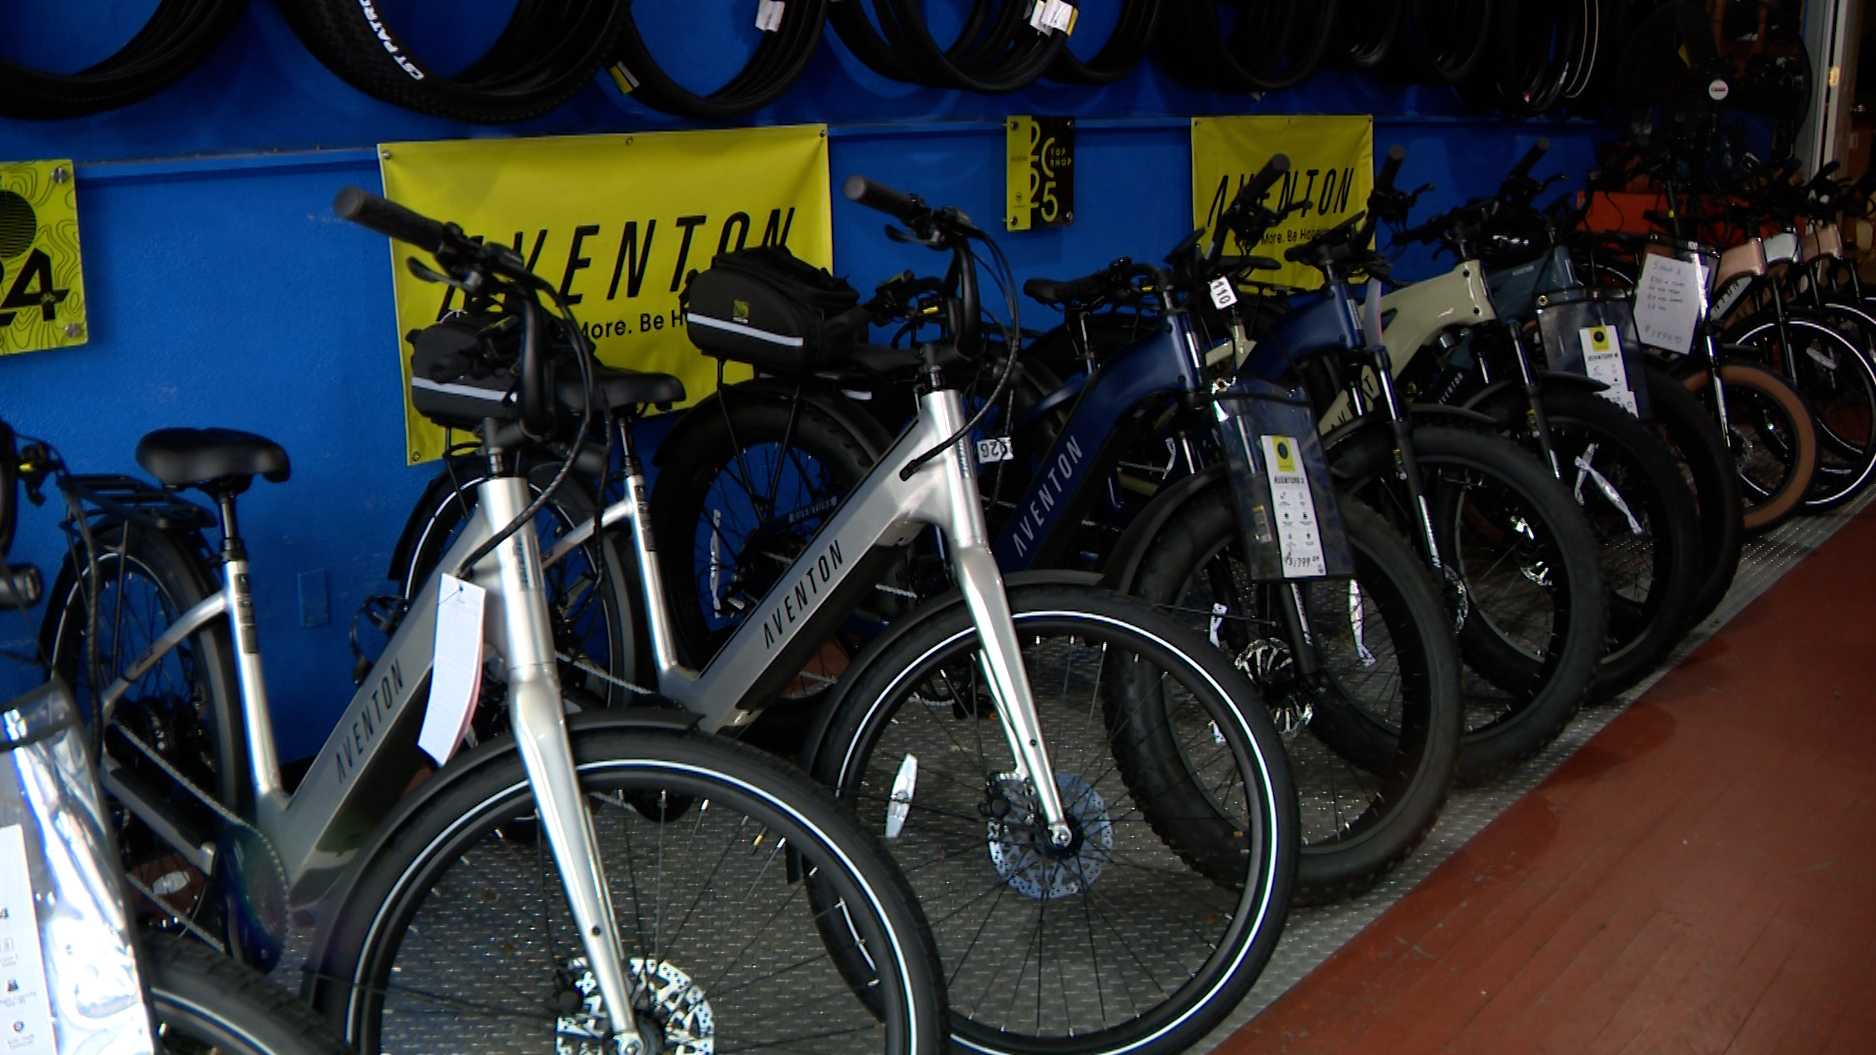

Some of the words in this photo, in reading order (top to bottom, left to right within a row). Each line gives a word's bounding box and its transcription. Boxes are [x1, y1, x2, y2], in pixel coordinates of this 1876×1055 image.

[1207, 168, 1354, 228] ANTON
[640, 313, 664, 332] Be
[1212, 281, 1232, 305] 110
[1012, 434, 1083, 559] AVENTON
[764, 539, 843, 650] AVENTON
[335, 658, 404, 785] AVENTON
